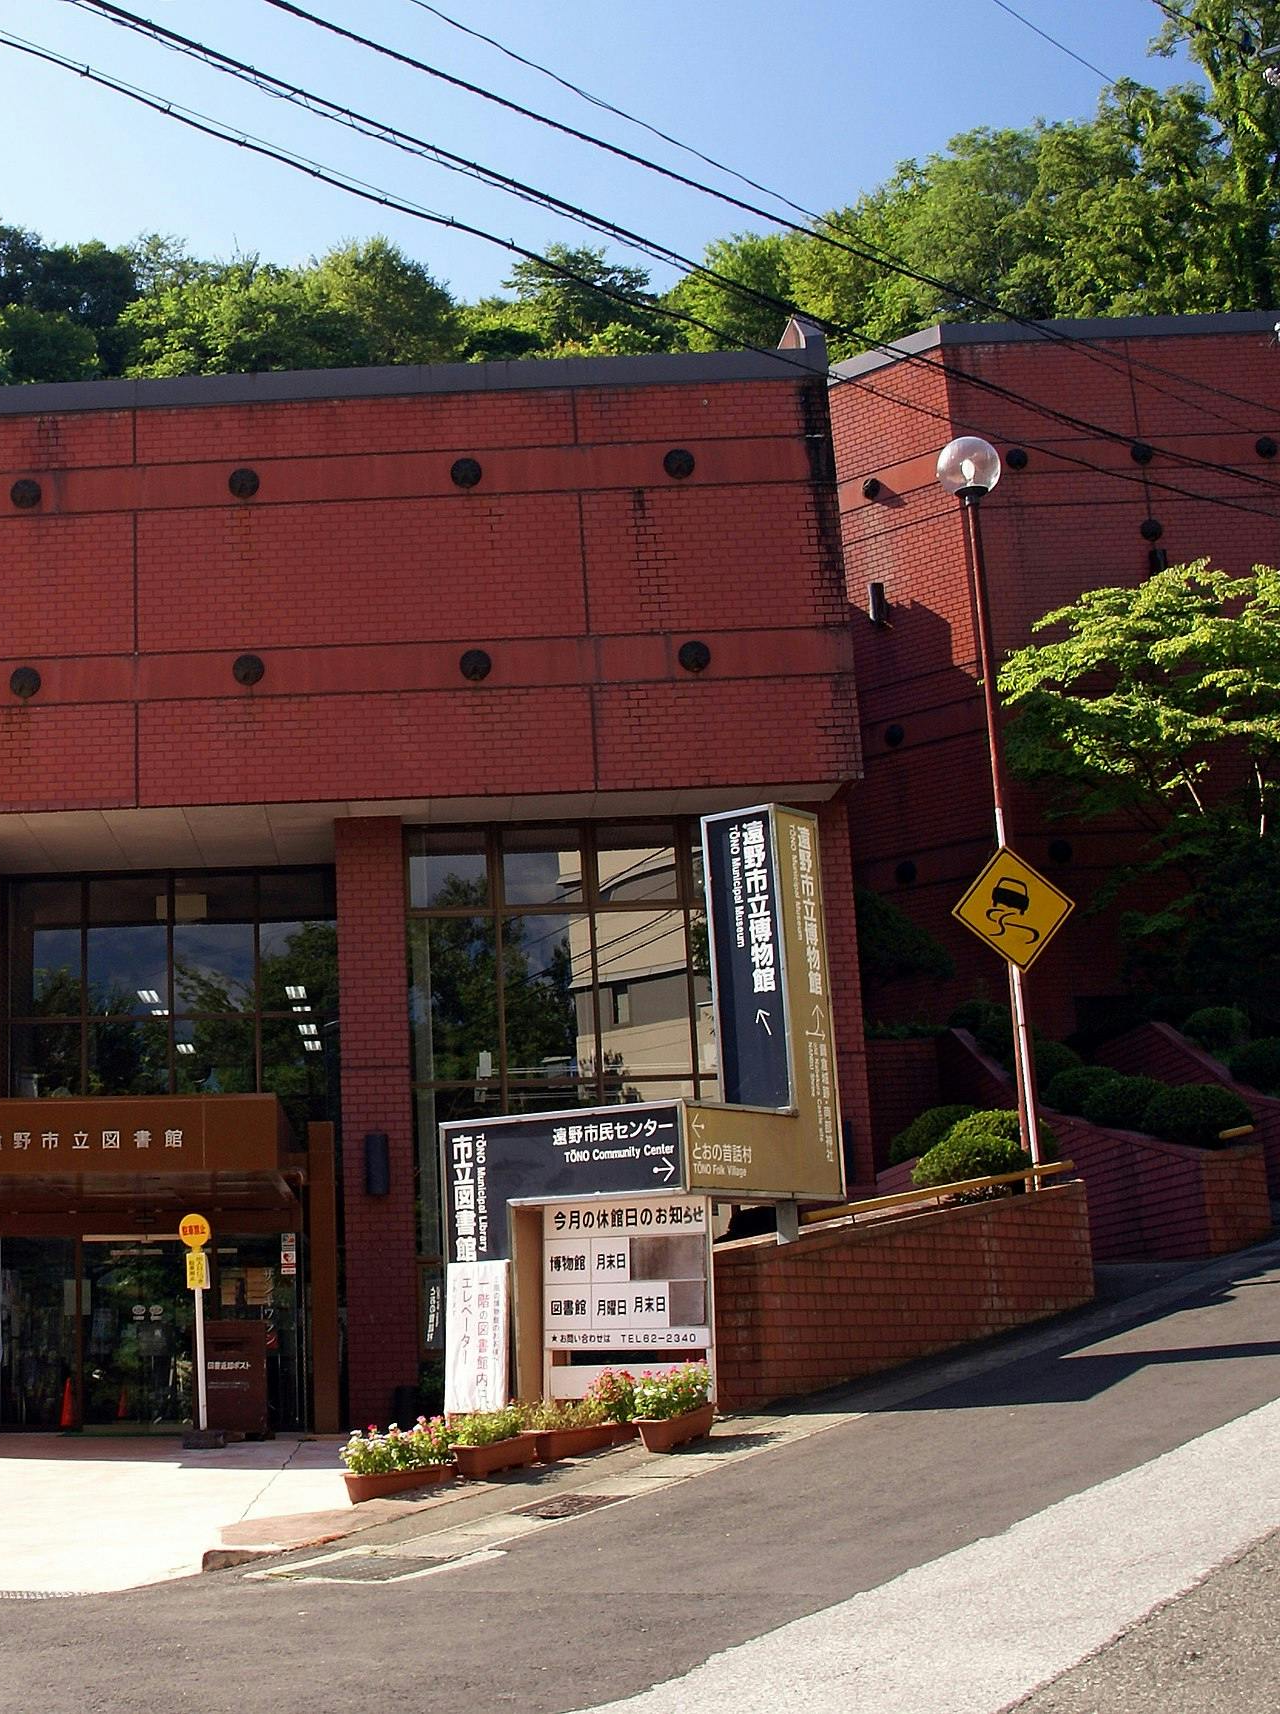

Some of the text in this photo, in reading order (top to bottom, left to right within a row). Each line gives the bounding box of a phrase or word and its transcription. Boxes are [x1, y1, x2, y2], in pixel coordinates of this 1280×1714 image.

[731, 856, 744, 905] Municipal
[791, 854, 800, 899] Municipal
[741, 820, 776, 993] 遠野市立博物館
[794, 901, 803, 941] Museum
[797, 826, 823, 996] 遠野市立博物館
[734, 906, 745, 948] Museum
[552, 1118, 674, 1146] 遠野市民センター
[592, 1145, 641, 1161] Community
[643, 1143, 675, 1157] Center
[692, 1143, 752, 1164] とおの昔話村
[712, 1164, 726, 1177] Folk
[727, 1164, 747, 1178] Village
[452, 1134, 477, 1262] 市立図書館
[476, 1166, 488, 1214] Municipal
[478, 1215, 488, 1253] Library
[554, 1206, 704, 1231] 今月の休館日のお知らせ
[550, 1253, 626, 1272] 博物館 月末日
[461, 1278, 472, 1364] エレベーター
[551, 1296, 666, 1315] 図書館 月曜日 月末日
